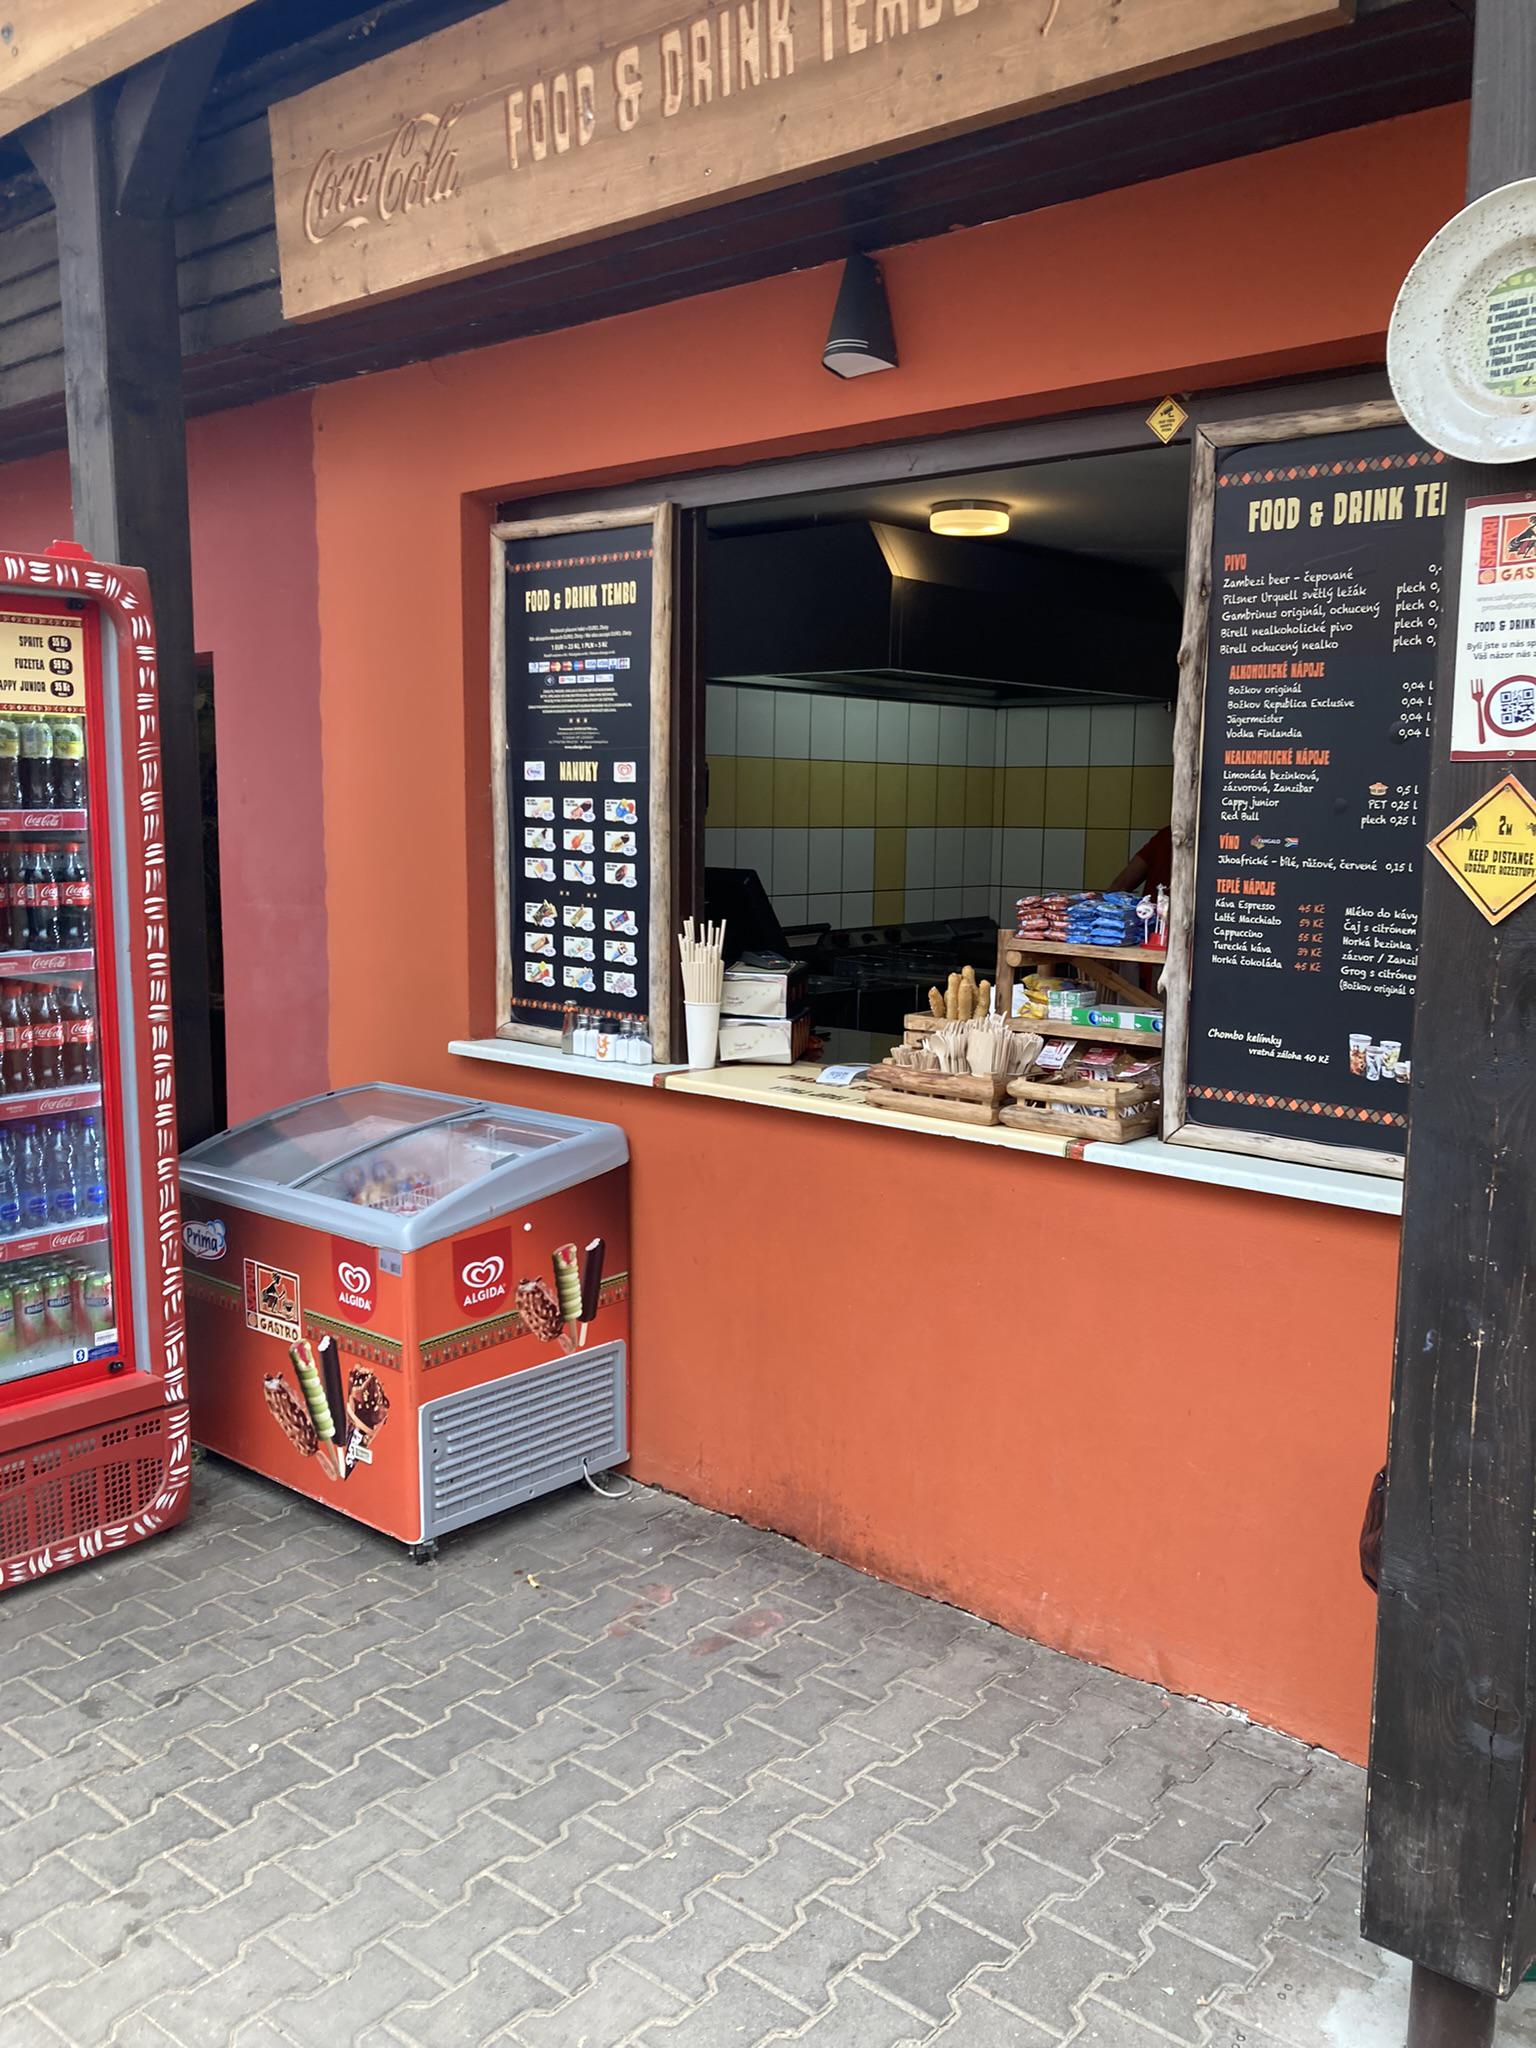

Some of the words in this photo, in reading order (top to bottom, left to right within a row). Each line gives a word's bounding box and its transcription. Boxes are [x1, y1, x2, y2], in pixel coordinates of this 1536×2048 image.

[507, 64, 595, 169] FOOD
[614, 47, 644, 131] &
[659, 0, 794, 118] DRINK
[1248, 497, 1300, 533] FOOD
[1310, 501, 1324, 528] &
[1333, 486, 1405, 526] DRINK
[1415, 481, 1448, 518] TE
[1481, 519, 1499, 567] SAFARI
[1224, 553, 1247, 571] PIVO
[1223, 574, 1264, 589] Zambezi
[1268, 573, 1290, 586] beer
[1303, 567, 1354, 588] čepované
[1501, 567, 1536, 582] GAS
[525, 589, 550, 613] FOOD
[554, 592, 561, 610] &
[565, 584, 598, 610] DRINK
[601, 581, 637, 607] TEMBO
[1222, 594, 1258, 605] Pilsner
[1261, 590, 1298, 607] Urquell
[1302, 587, 1334, 604] světlý
[1337, 584, 1368, 598] ležák
[1396, 580, 1426, 600] plech
[1221, 608, 1277, 622] Gambrinus
[1280, 604, 1326, 622] originál,
[1329, 602, 1381, 618] ochucený
[1395, 598, 1425, 618] plech
[1220, 627, 1248, 639] Birell
[1251, 620, 1326, 636] nealkoholické
[1330, 622, 1353, 638] pivo
[1394, 616, 1424, 635] plech
[1474, 621, 1496, 632] FOOD
[1500, 620, 1506, 631] &
[1510, 618, 1536, 630] DRINK
[18, 636, 44, 648] SPRITE
[1220, 644, 1248, 655] Birell
[1250, 640, 1299, 656] ochucený
[1302, 639, 1339, 650] nealko
[1392, 634, 1422, 652] plech
[1466, 642, 1482, 651] Byli
[1484, 640, 1500, 650] jste
[1510, 640, 1524, 649] nás
[14, 658, 45, 670] FUZETEA
[1489, 650, 1514, 660] názor
[1516, 650, 1531, 658] nás
[1229, 660, 1288, 680] ALKOHOLICKÉ
[1290, 660, 1326, 678] NÁPOJE
[0, 680, 17, 691] APPY
[20, 680, 46, 692] JUNIOR
[1228, 685, 1262, 695] Božkov
[1264, 682, 1302, 697] originál
[1402, 682, 1426, 692] 0,04
[1429, 680, 1434, 690] l
[1228, 700, 1260, 710] Božkov
[1263, 698, 1308, 714] Republica
[1311, 698, 1356, 708] Exclusive
[1401, 697, 1424, 708] 0,04
[1428, 696, 1433, 706] l
[1226, 714, 1284, 726] Jägermeister
[1400, 712, 1423, 724] 0,04
[1426, 712, 1432, 722] l
[1226, 729, 1254, 738] Vodka
[1257, 728, 1303, 739] Finlandia
[1398, 728, 1422, 740] 0,04
[1425, 727, 1430, 737] l
[1224, 748, 1293, 766] NEALKOHOLICKÉ
[1296, 748, 1331, 766] NÁPOJE
[560, 761, 598, 782] NANUKY
[1223, 770, 1268, 781] Limonáda
[1270, 770, 1320, 782] bezinková,
[1222, 782, 1271, 794] zázvorová,
[1273, 783, 1314, 794] Zanzibar
[1396, 785, 1412, 797] 0,5
[1221, 798, 1248, 812] Cappy
[1250, 798, 1280, 809] junior
[1368, 800, 1388, 810] PET
[1390, 800, 1410, 812] 0,25
[1220, 812, 1239, 821] Red
[1241, 812, 1260, 822] Bull
[1360, 814, 1387, 830] plech
[1390, 816, 1409, 828] 0,25
[1219, 832, 1241, 850] VÍNO
[1218, 854, 1268, 867] Jihoafrické
[1280, 855, 1300, 870] bílé,
[1302, 857, 1336, 871] růžové,
[1339, 859, 1378, 872] červené
[1385, 863, 1406, 874] 0,15
[1468, 848, 1488, 862] KEEP
[1492, 850, 1534, 866] DISTANCE
[1216, 877, 1241, 894] TEPLÉ
[1243, 878, 1276, 896] NÁPOJE
[1215, 897, 1236, 908] Káva
[1238, 900, 1276, 914] Espresso
[1314, 904, 1326, 914] Kč
[1214, 912, 1236, 922] Latté
[1238, 914, 1282, 926] Macchiato
[1312, 918, 1325, 928] Kč
[1345, 905, 1374, 918] Mléko
[1376, 907, 1391, 918] do
[1394, 908, 1418, 926] kávy
[1213, 926, 1264, 941] Cappuccino
[1312, 932, 1324, 943] Kč
[1343, 918, 1362, 936] Čaj
[1364, 924, 1369, 932] s
[1372, 923, 1416, 936] citrónem
[1213, 940, 1248, 952] Turecká
[1250, 942, 1272, 954] káva
[1310, 947, 1322, 958] Kč
[1342, 936, 1371, 948] Horká
[1374, 936, 1412, 950] bezinka
[1212, 954, 1238, 966] Horká
[1240, 956, 1283, 969] čokoláda
[1309, 962, 1322, 972] Kč
[1341, 949, 1375, 962] zázvor
[1340, 966, 1367, 980] Grog
[1369, 970, 1376, 978] s
[1378, 968, 1416, 981] citróne
[1338, 978, 1372, 993] (Božkov
[1374, 984, 1406, 997] originál
[1208, 1028, 1244, 1042] Chombo
[1246, 1031, 1282, 1048] kelímky
[1248, 1047, 1275, 1058] vratná
[1276, 1048, 1302, 1061] záloha
[1318, 1054, 1330, 1064] Kč
[186, 1227, 218, 1252] Prima
[338, 1292, 372, 1311] ALGIDA
[463, 1284, 506, 1306] ALGIDA
[260, 1318, 299, 1341] GASTRO
